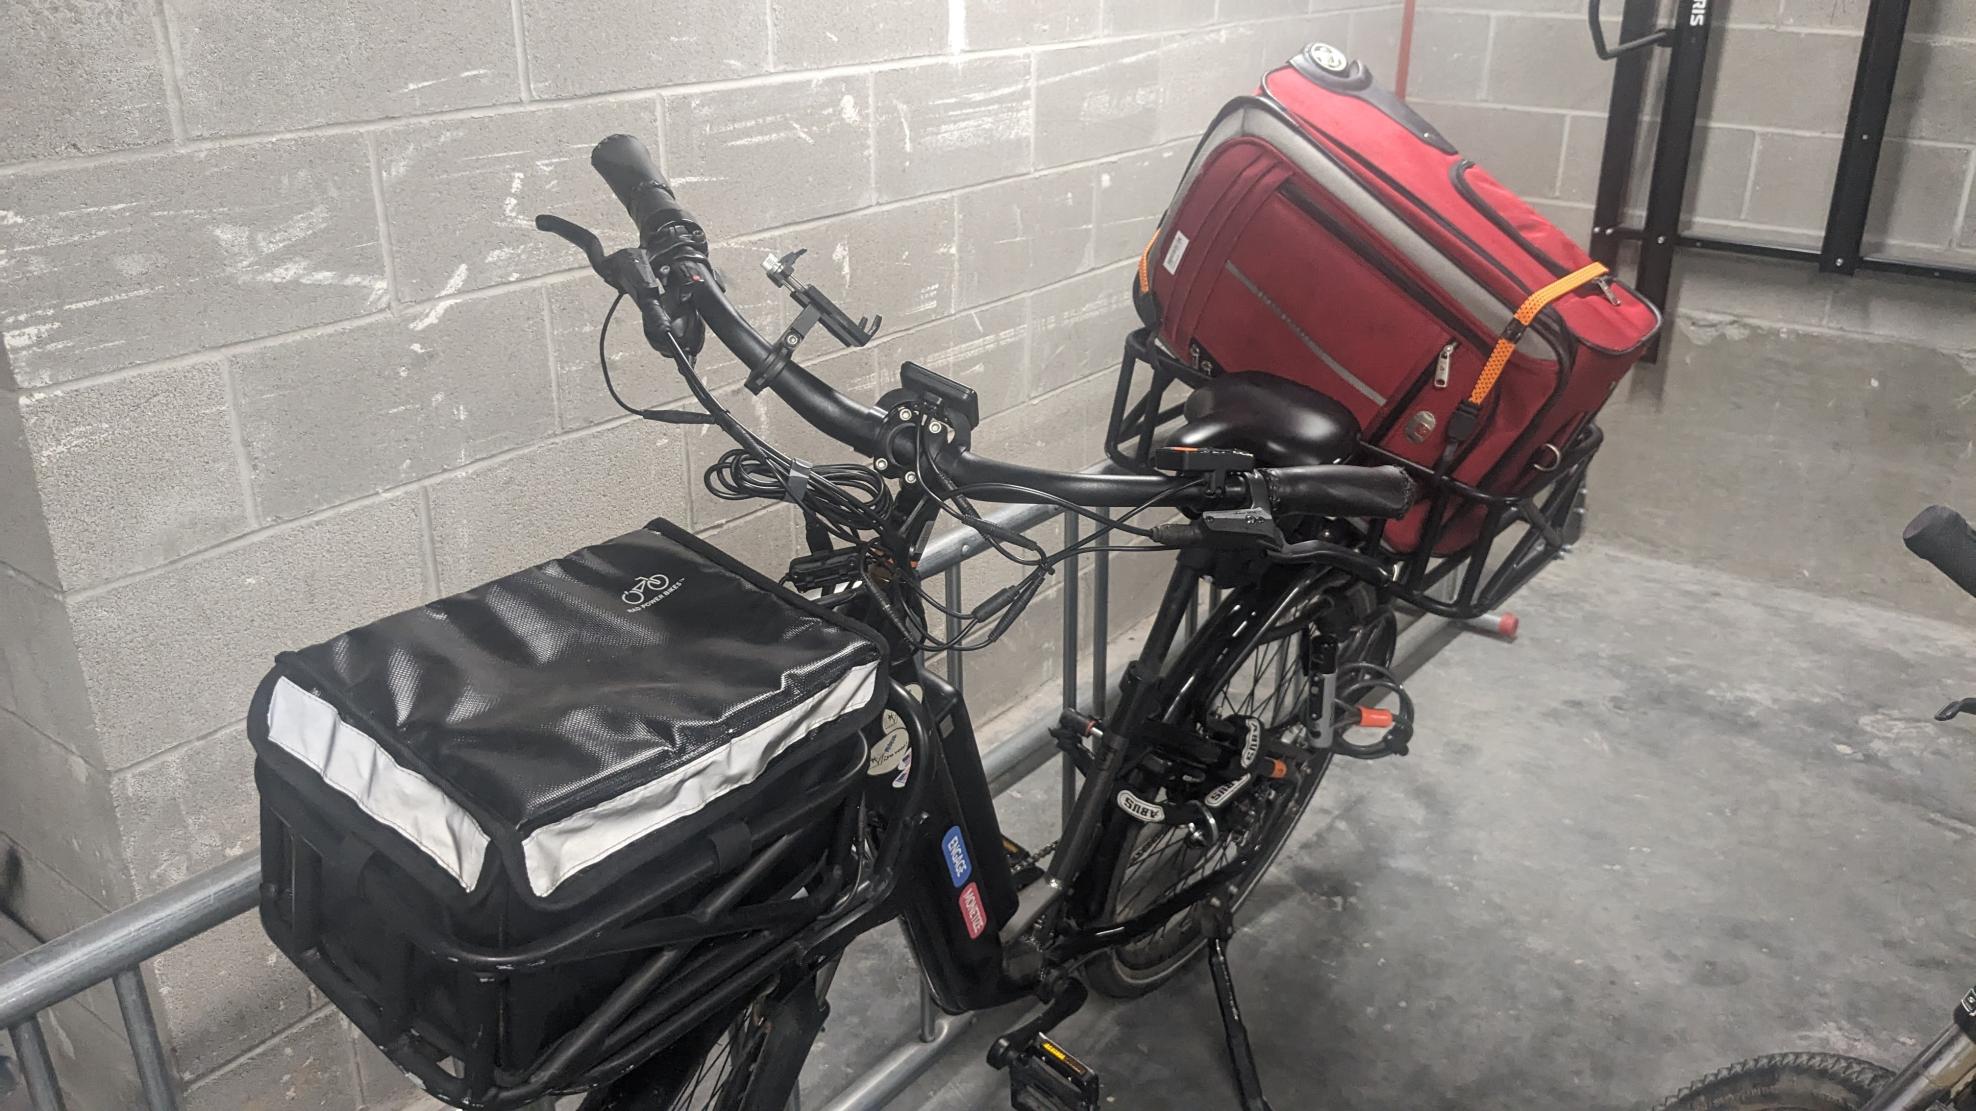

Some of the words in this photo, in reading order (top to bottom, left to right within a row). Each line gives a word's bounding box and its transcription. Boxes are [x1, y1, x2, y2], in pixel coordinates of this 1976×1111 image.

[640, 594, 665, 609] POWER
[1246, 722, 1258, 761] ABUS
[1123, 796, 1160, 819] ABUS
[947, 835, 967, 878] ENGAGE
[963, 887, 984, 934] MONETIZE
